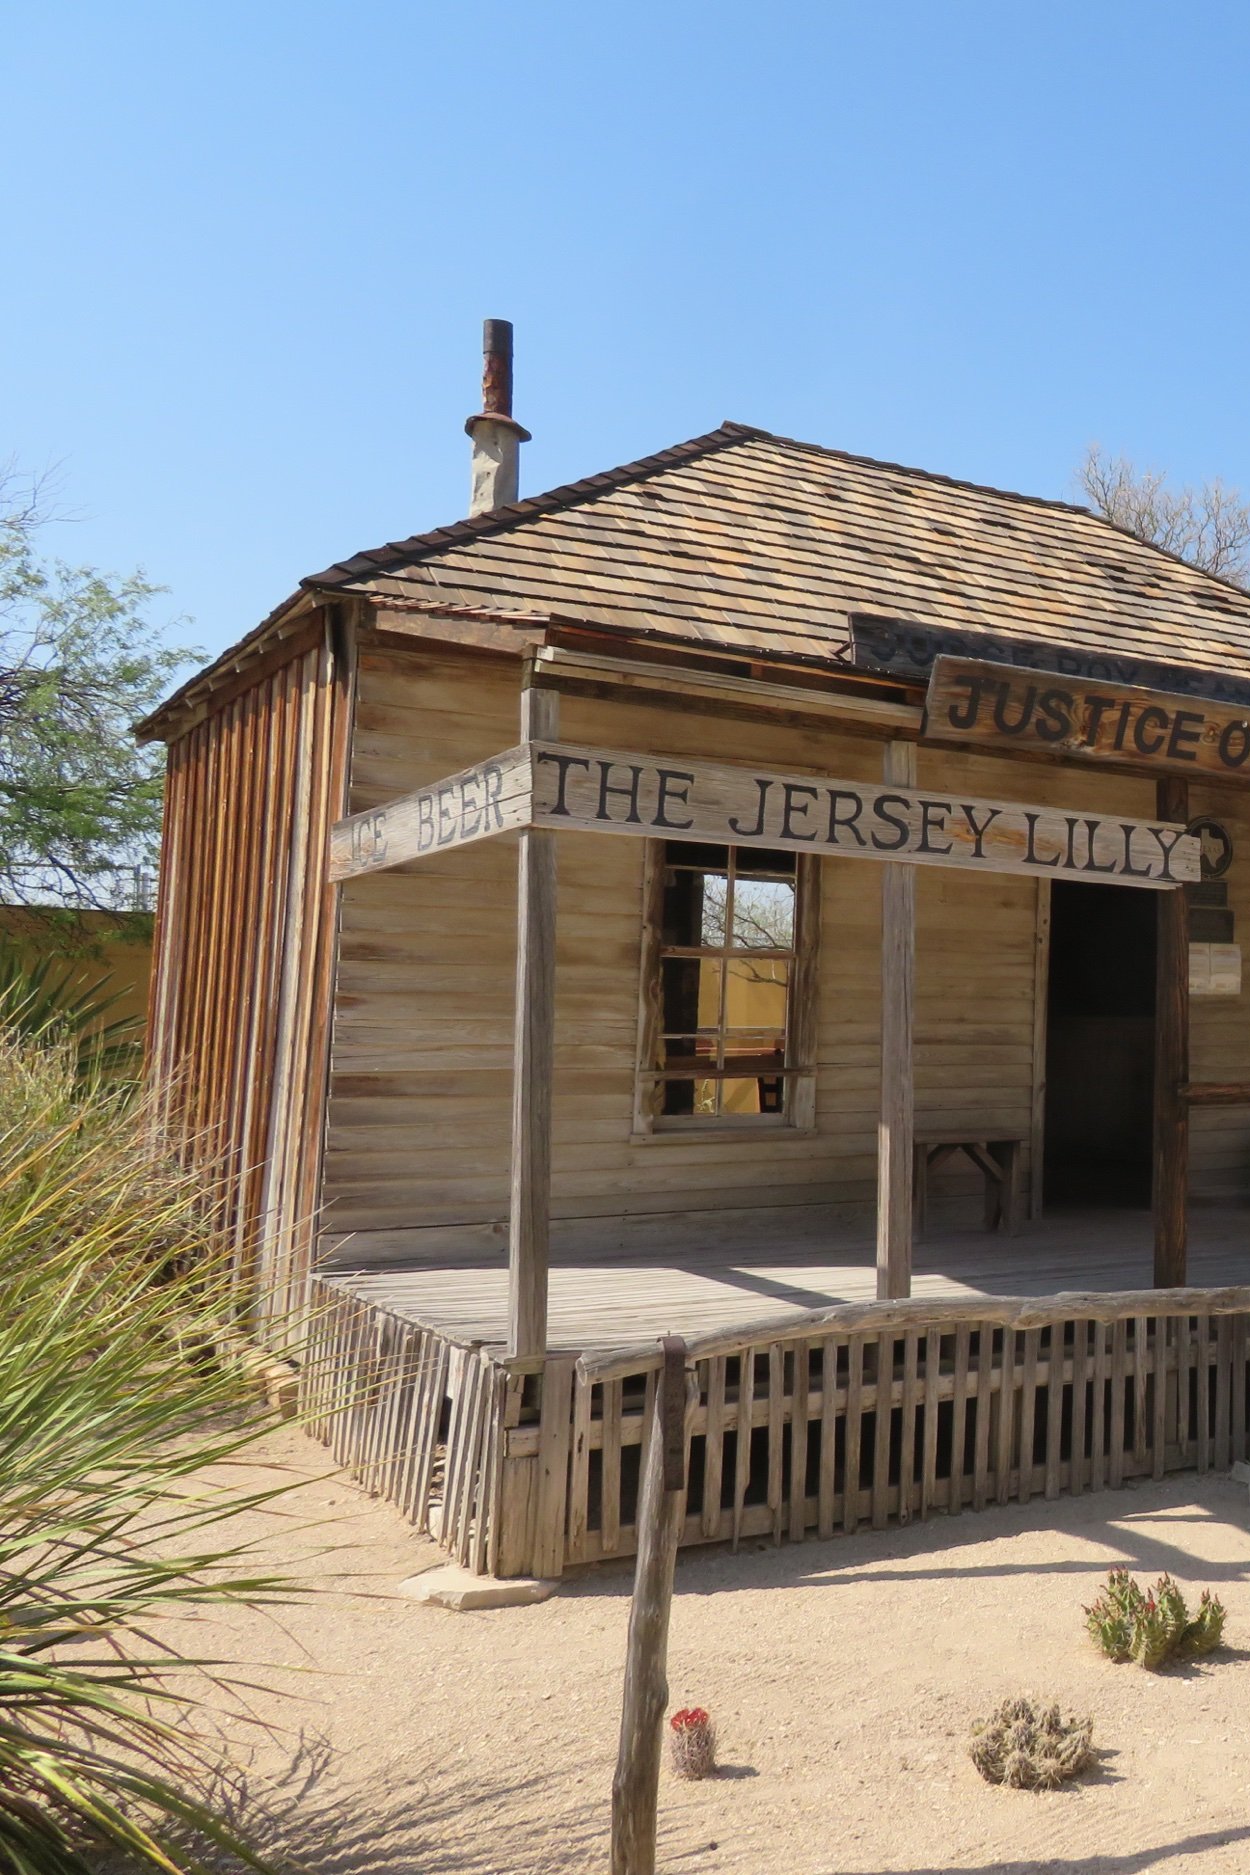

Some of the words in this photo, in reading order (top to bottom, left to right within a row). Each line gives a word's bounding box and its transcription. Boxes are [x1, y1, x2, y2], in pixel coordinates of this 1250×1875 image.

[948, 675, 1205, 761] JUSTICE
[417, 765, 504, 852] BEER
[537, 751, 695, 829] THE
[728, 779, 1002, 858] JERSEY
[1022, 812, 1184, 880] LILLY
